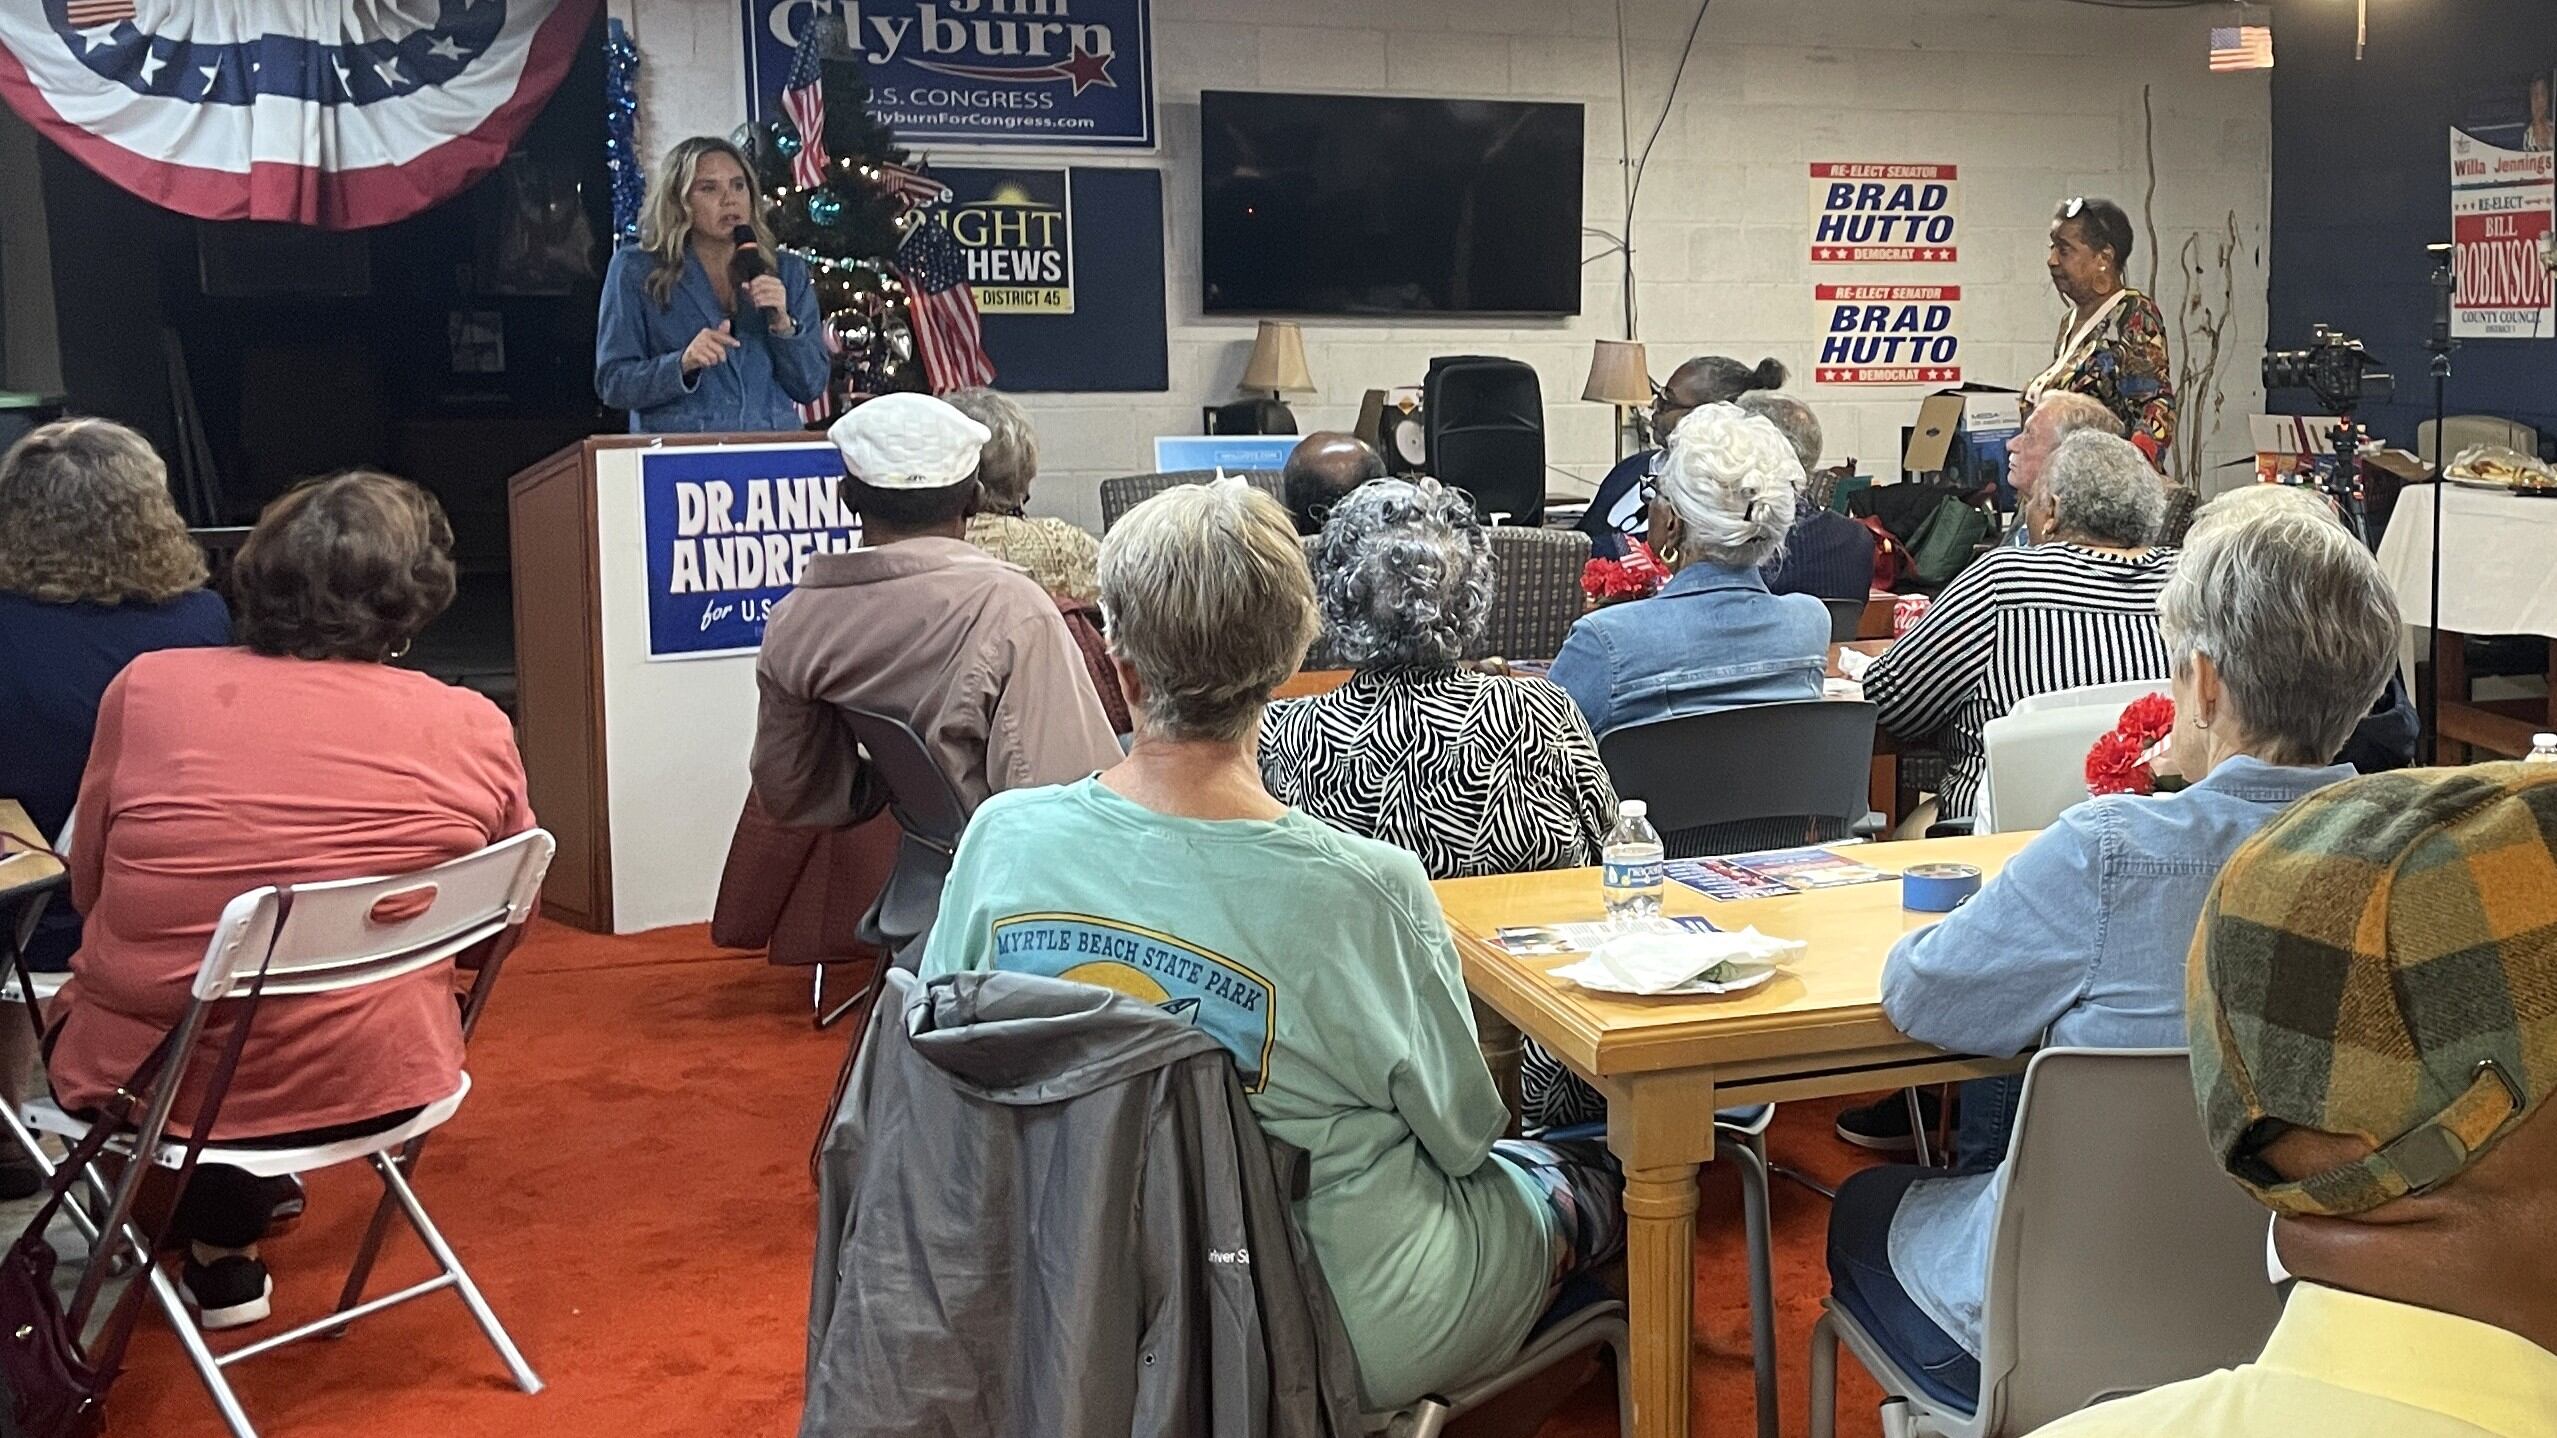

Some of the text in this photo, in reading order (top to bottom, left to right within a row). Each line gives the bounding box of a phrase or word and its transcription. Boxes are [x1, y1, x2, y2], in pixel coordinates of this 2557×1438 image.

[769, 0, 1116, 65] Clyburn
[910, 88, 1054, 110] CONGRESS
[1830, 164, 1938, 178] RE-ELECT SENATOR
[2454, 153, 2552, 177] Willa Jennings
[1825, 183, 1949, 212] BRAD
[1815, 214, 1955, 243] HUTTO
[2485, 215, 2518, 238] BILL
[960, 249, 1062, 282] HEWS
[1854, 248, 1916, 261] DEMOCRAT
[2455, 238, 2550, 305] ROBINSON
[983, 289, 1061, 306] DISTRICT 45
[1835, 287, 1943, 300] RE-ELECT SENATOR
[1829, 305, 1953, 333] BRAD
[2461, 309, 2542, 324] COUNTY COUNCIL
[1819, 336, 1958, 364] HUTTO
[1858, 369, 1920, 382] DEMOCRAT
[701, 599, 733, 632] for
[996, 929, 1263, 1012] MYRTLE BEACH STATE PARK
